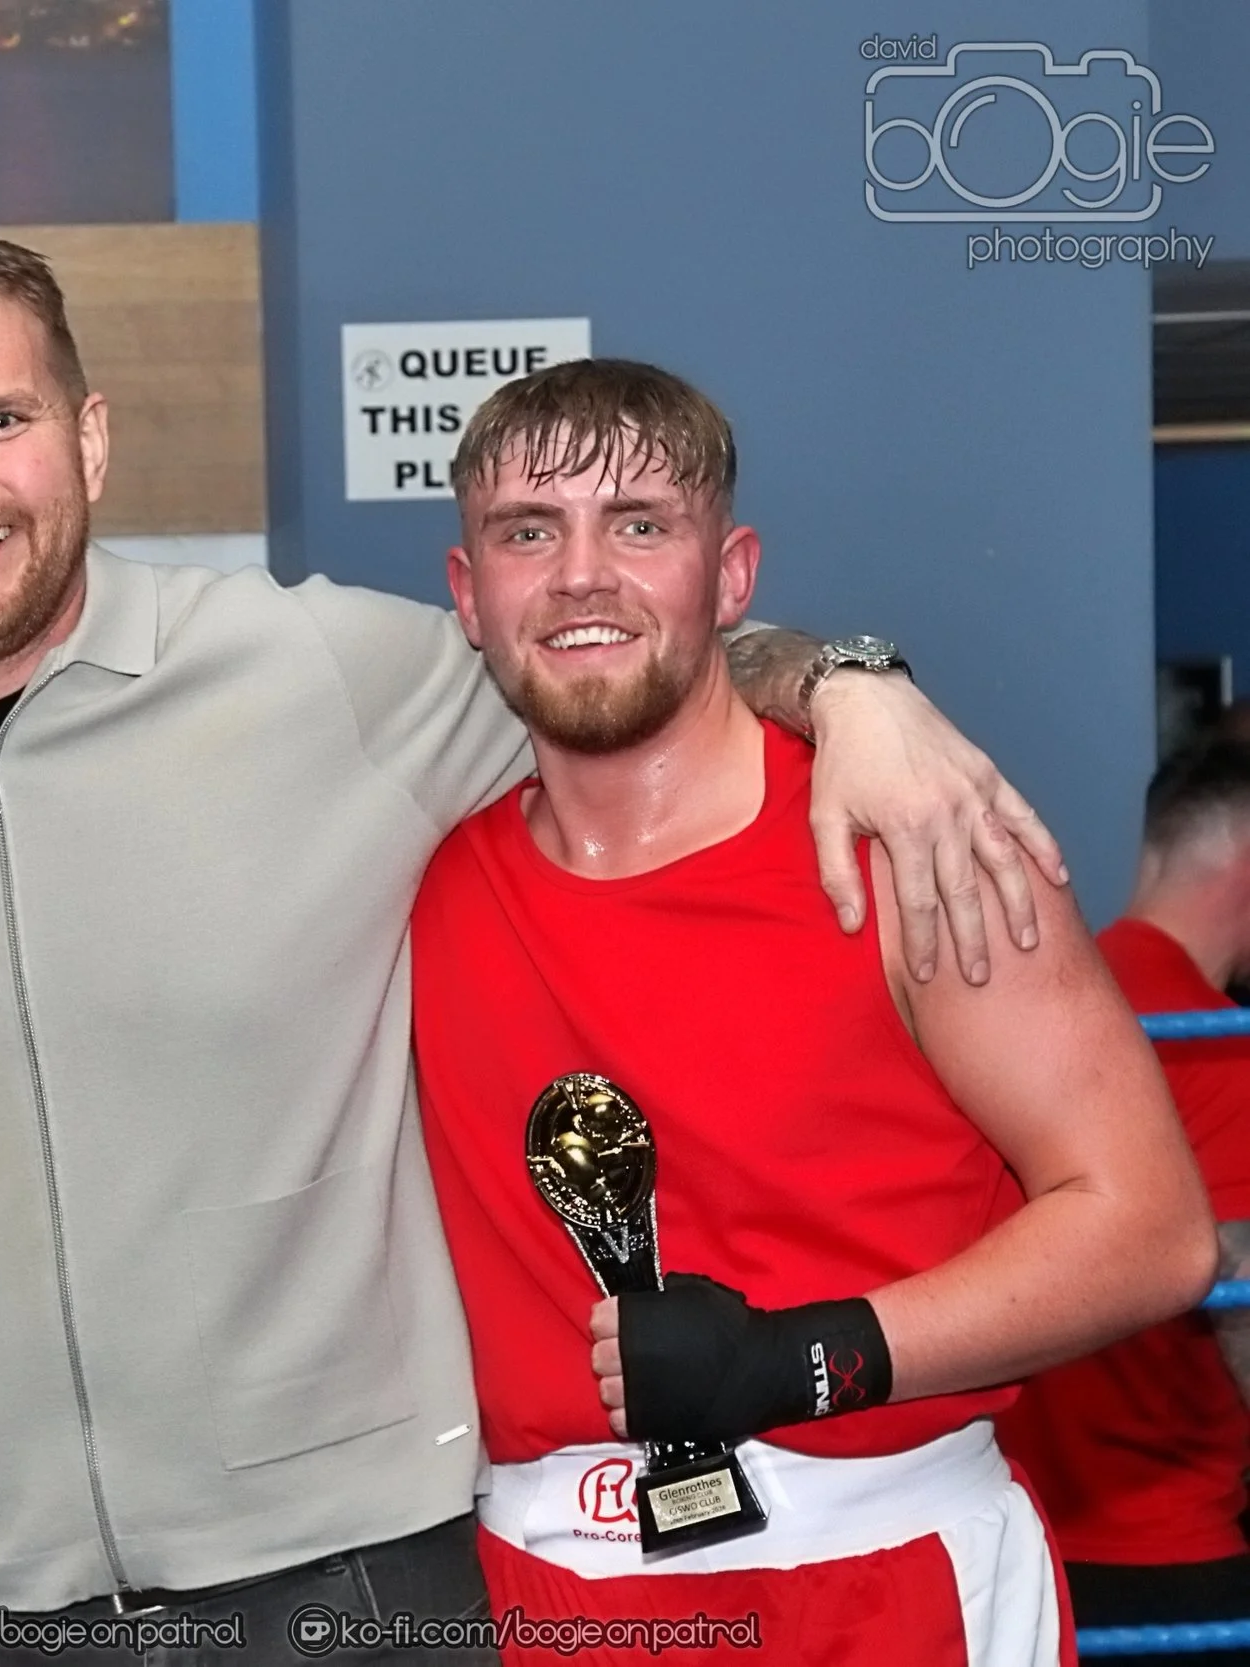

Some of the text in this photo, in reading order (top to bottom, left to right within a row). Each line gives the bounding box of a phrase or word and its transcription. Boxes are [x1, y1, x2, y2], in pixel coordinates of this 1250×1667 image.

[400, 346, 548, 381] QUEUE
[361, 404, 462, 435] THIS
[659, 1478, 722, 1501] Glenrothes
[669, 1495, 721, 1515] CISWO CLUB
